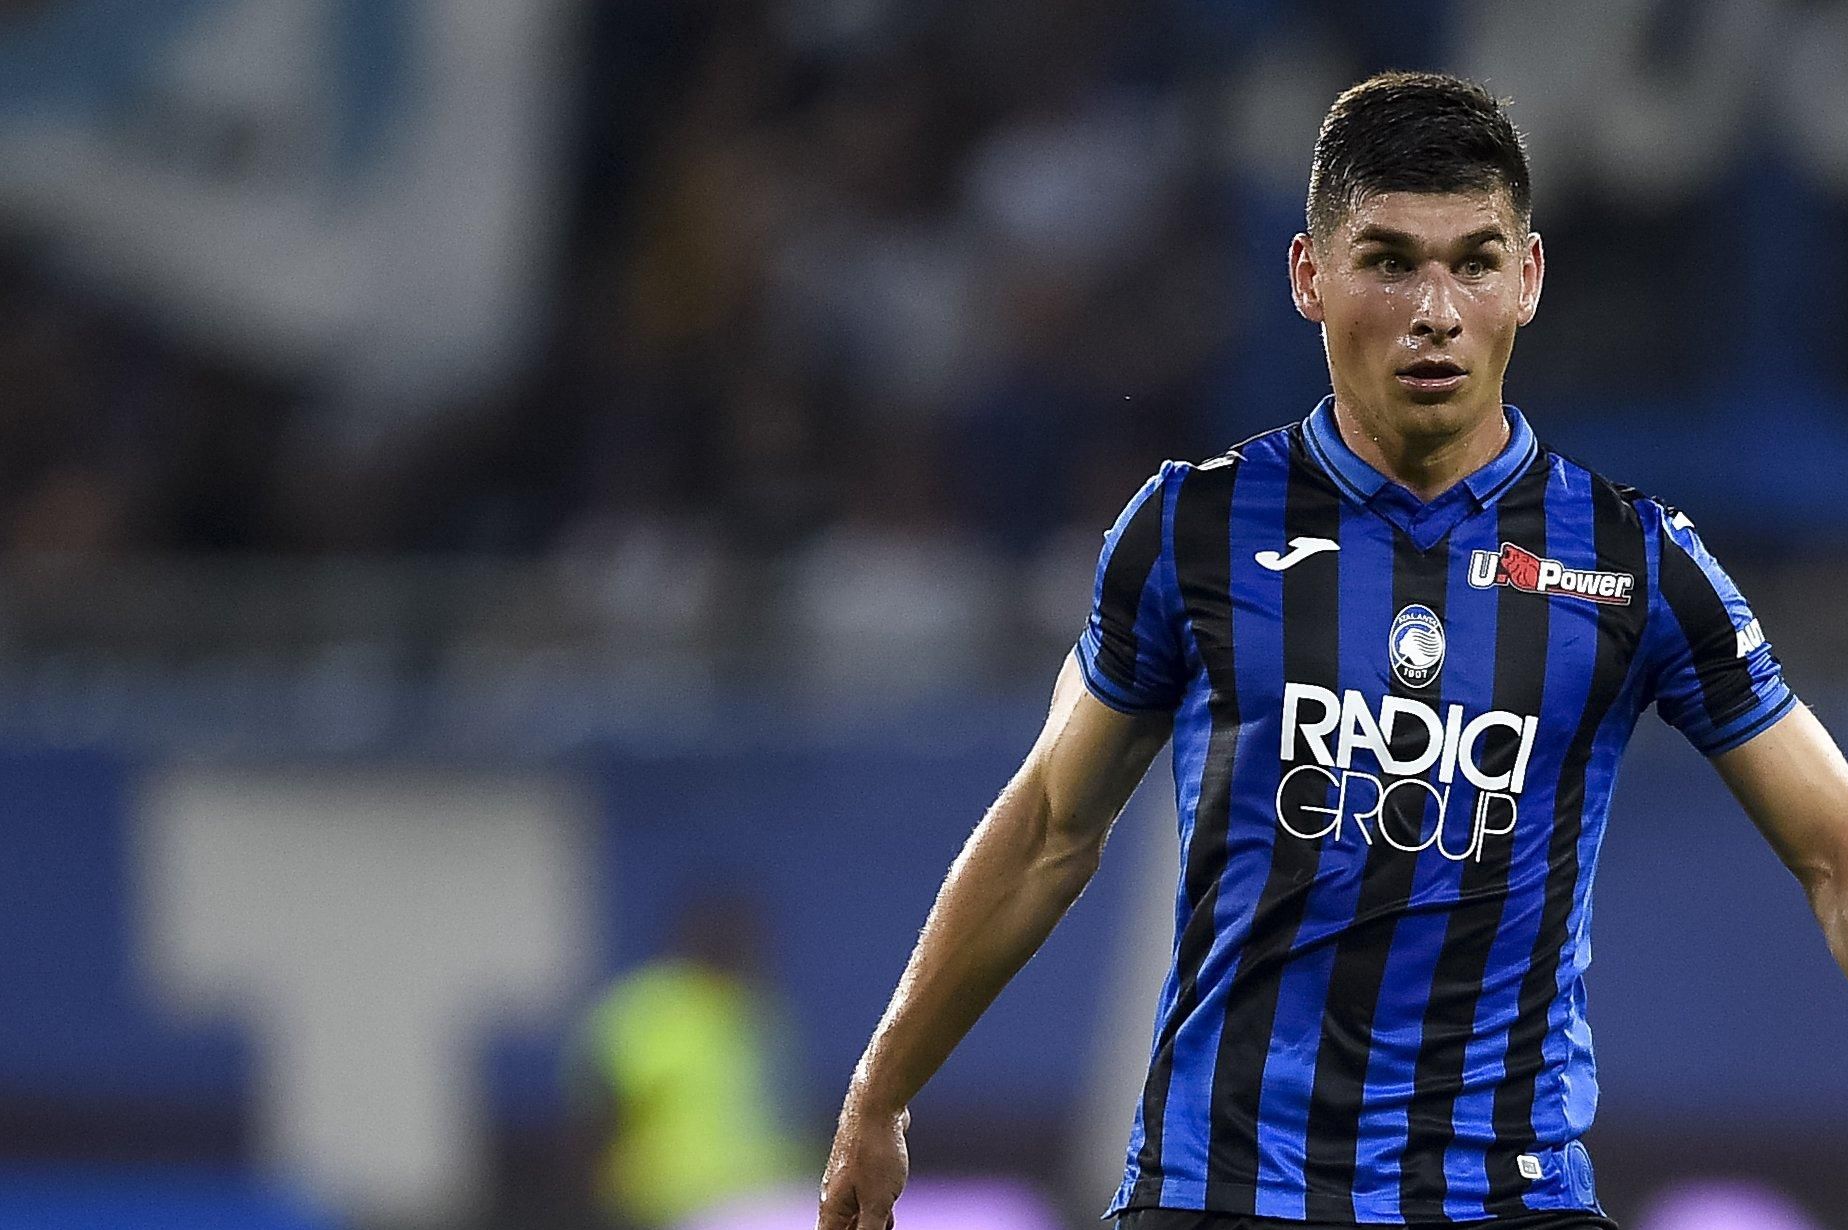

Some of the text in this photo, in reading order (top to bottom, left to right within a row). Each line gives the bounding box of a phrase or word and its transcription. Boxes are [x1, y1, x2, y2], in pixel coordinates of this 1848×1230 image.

[1537, 561, 1632, 598] Power
[1280, 682, 1539, 794] RADICI
[1276, 764, 1518, 863] GROUP
